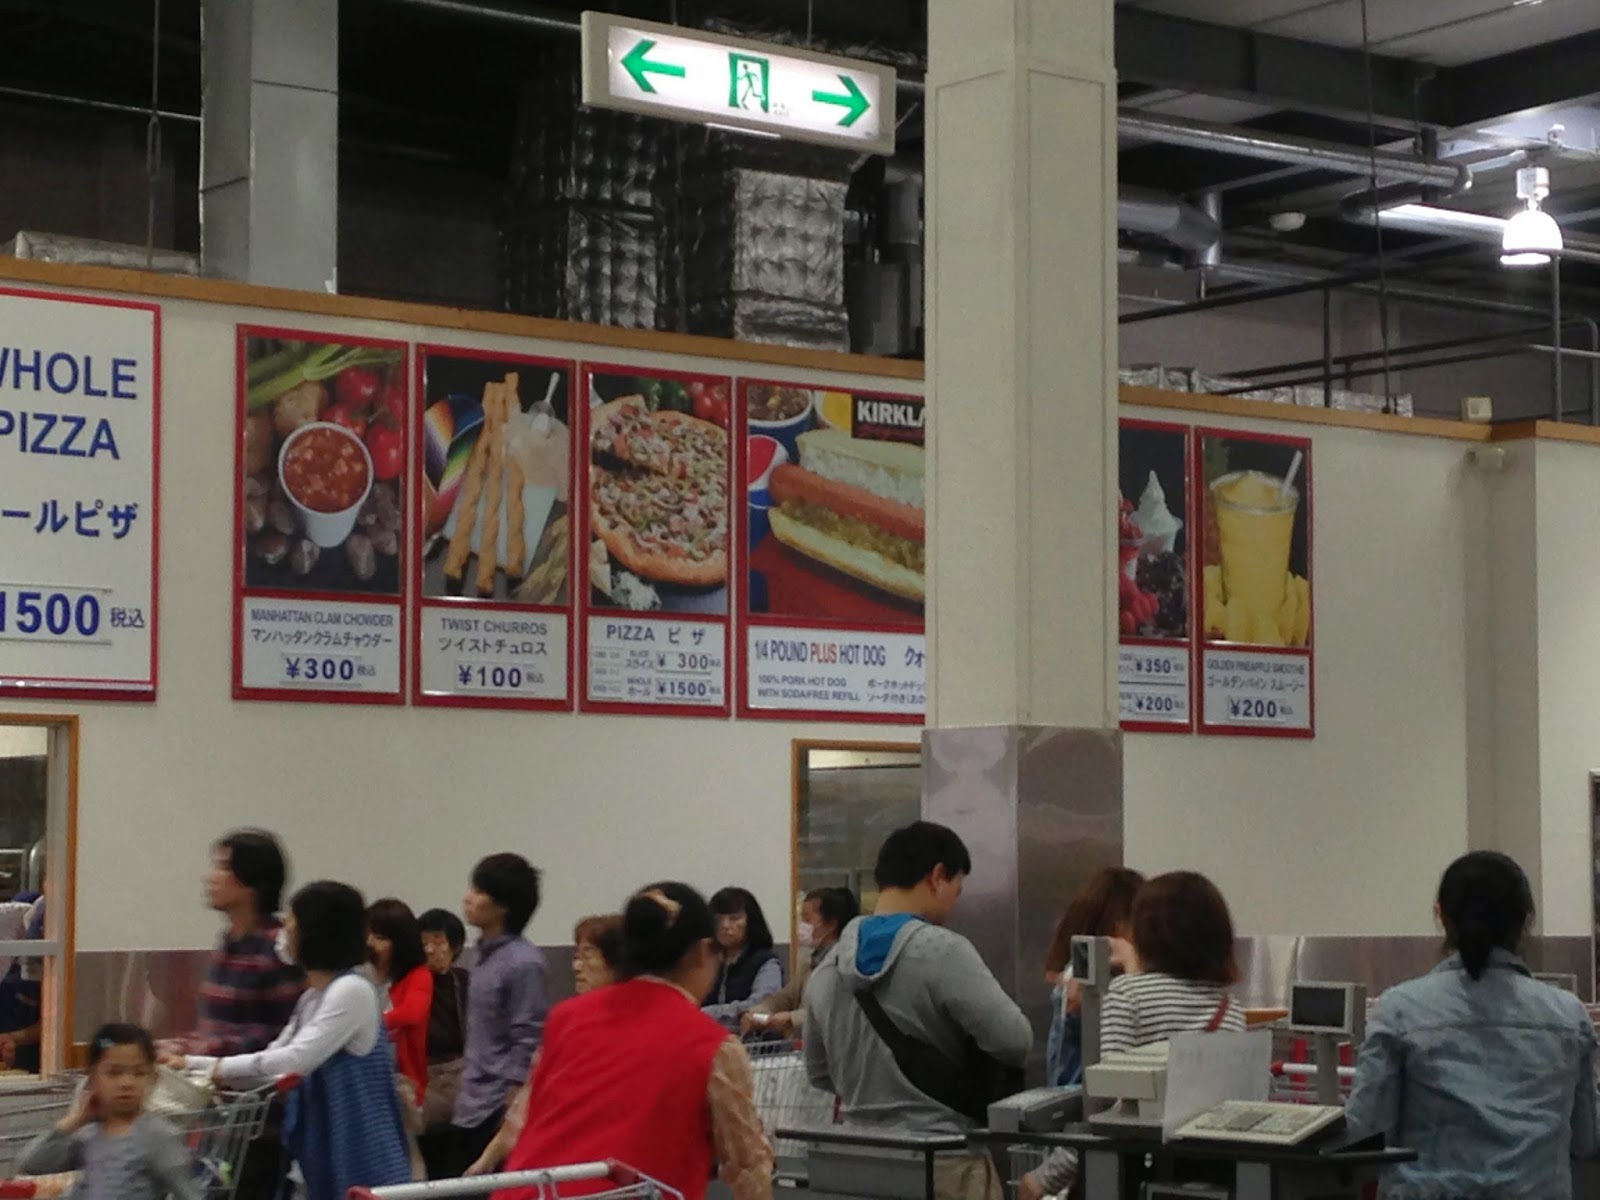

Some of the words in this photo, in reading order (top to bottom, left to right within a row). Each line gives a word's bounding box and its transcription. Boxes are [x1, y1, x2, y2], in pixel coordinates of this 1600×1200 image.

[0, 346, 138, 400] HOLE
[251, 608, 312, 624] MANHATTAN
[314, 611, 341, 625] CLAM
[343, 612, 394, 627] CHOWDER
[441, 617, 480, 632] TWIST
[484, 620, 548, 636] CHURROS
[606, 624, 656, 641] PIZZA
[770, 640, 807, 662] POUND
[810, 642, 837, 664] PLUS
[839, 644, 860, 664] HOT
[863, 644, 886, 666] DOG
